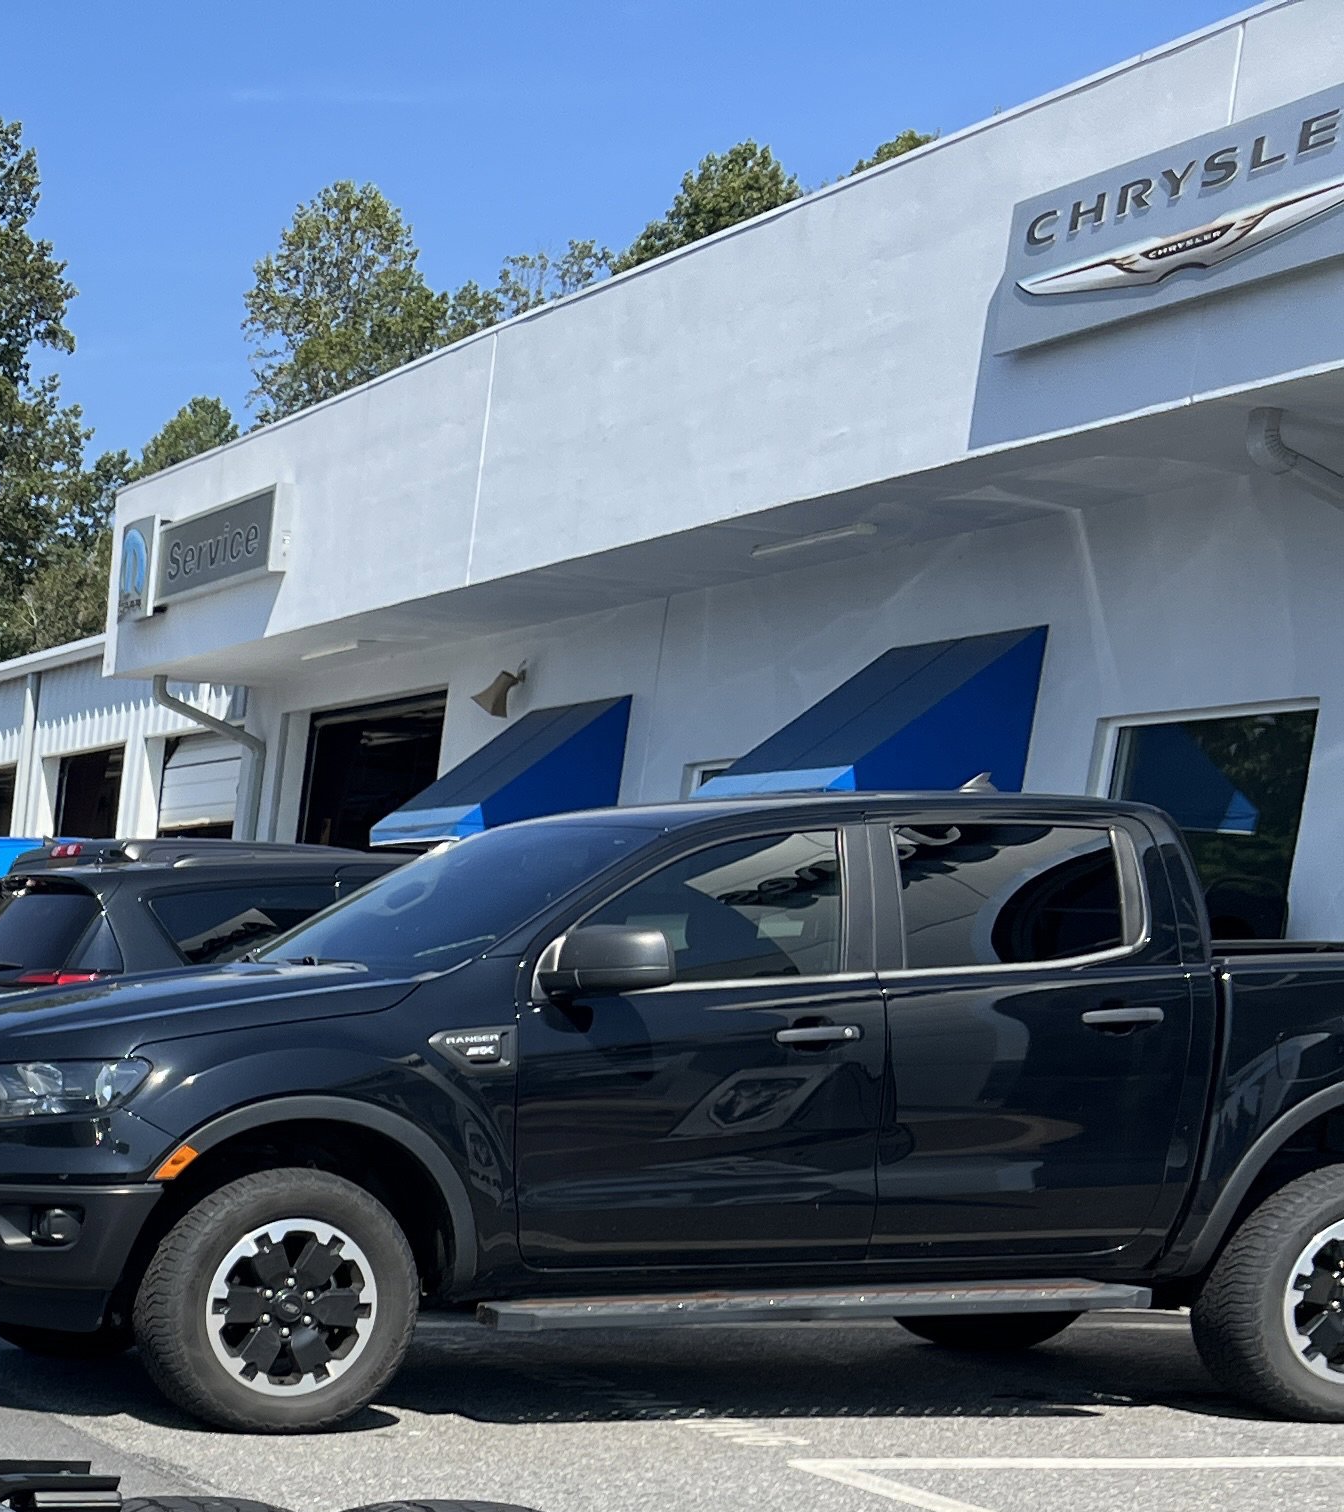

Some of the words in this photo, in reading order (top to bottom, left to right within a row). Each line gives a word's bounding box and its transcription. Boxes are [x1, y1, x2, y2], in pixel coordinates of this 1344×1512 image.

[1026, 107, 1341, 248] CHRYSLE
[1148, 230, 1221, 259] CHRYSLER
[167, 521, 260, 581] Service
[445, 1033, 499, 1045] RANGER
